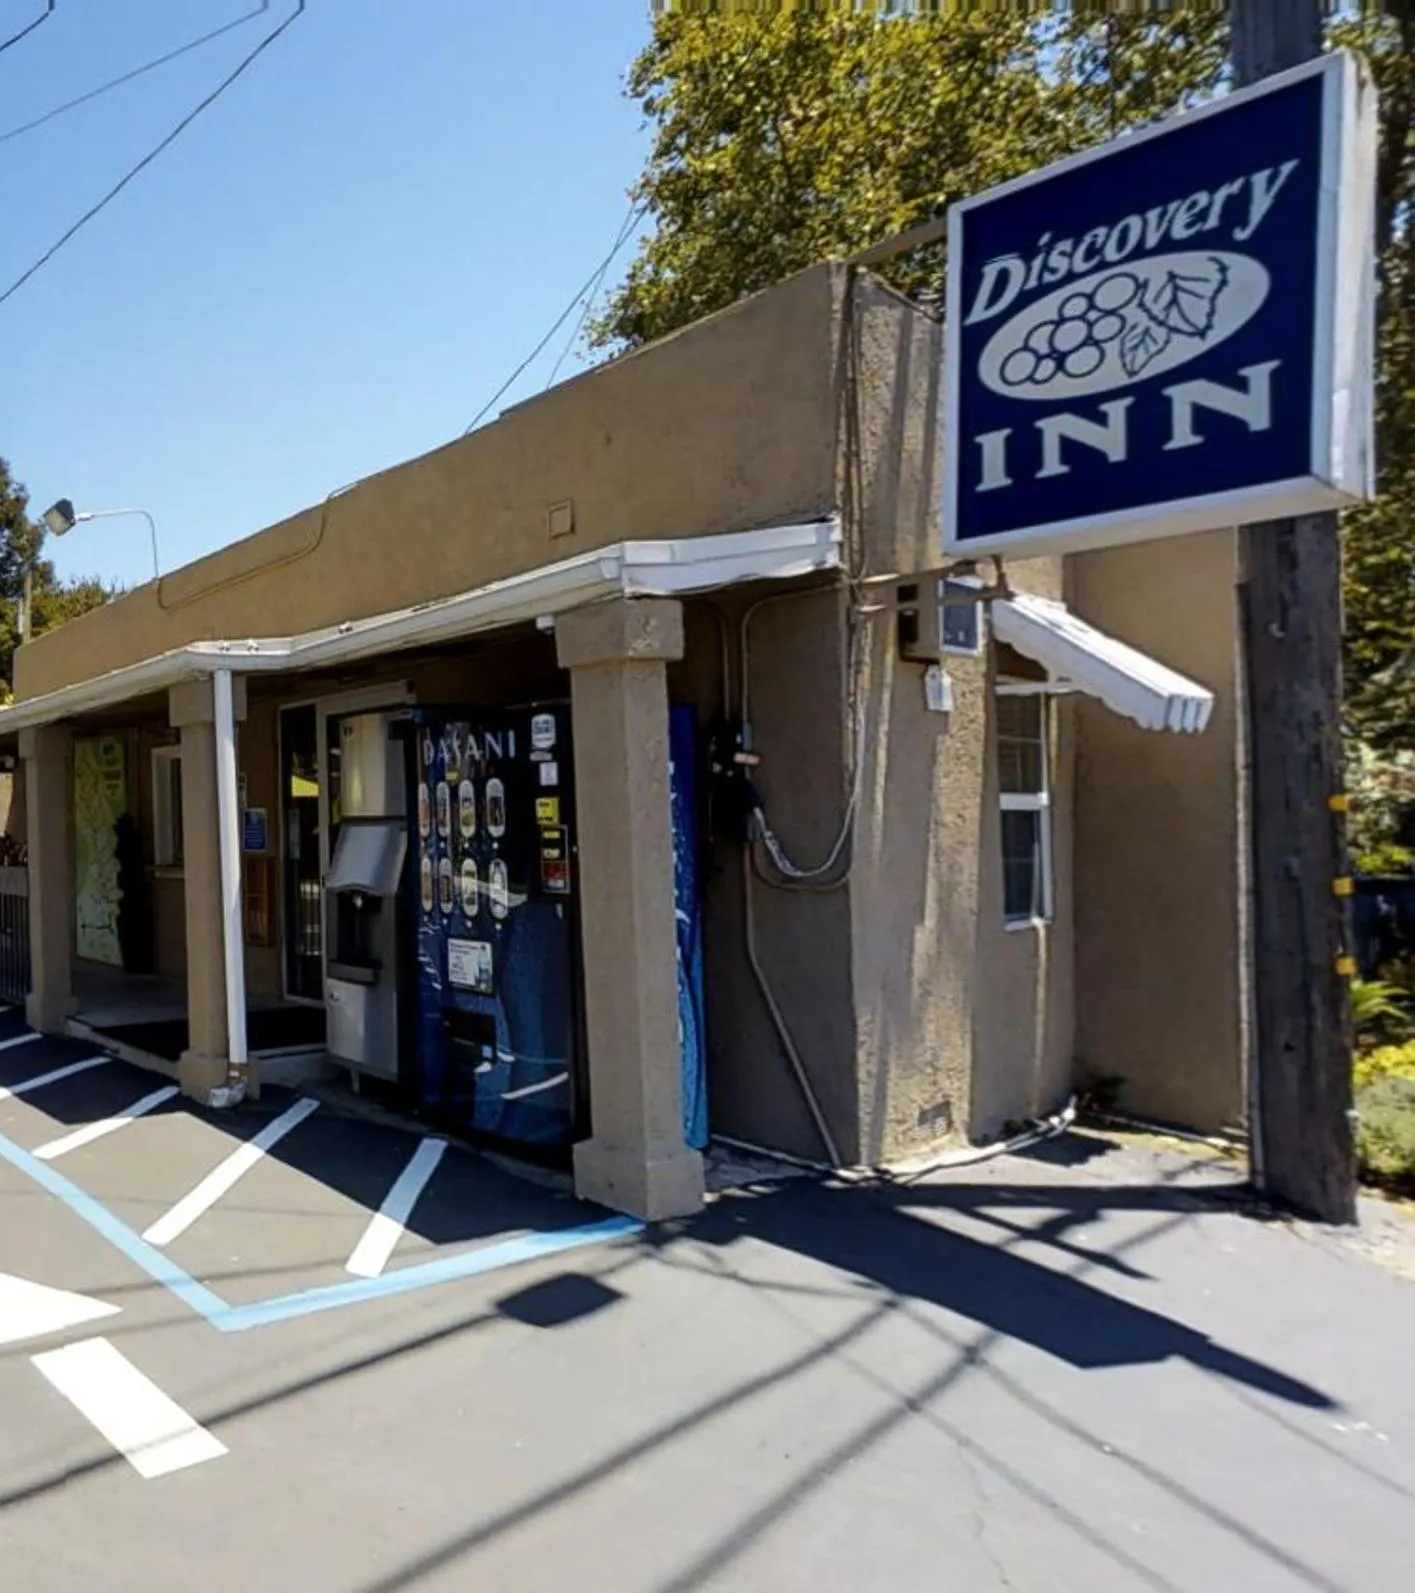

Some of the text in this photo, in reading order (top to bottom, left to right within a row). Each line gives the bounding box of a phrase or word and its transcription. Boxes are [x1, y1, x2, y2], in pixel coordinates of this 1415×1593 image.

[963, 157, 1301, 327] Discovery
[973, 359, 1282, 493] INN
[423, 729, 515, 766] DASANI
